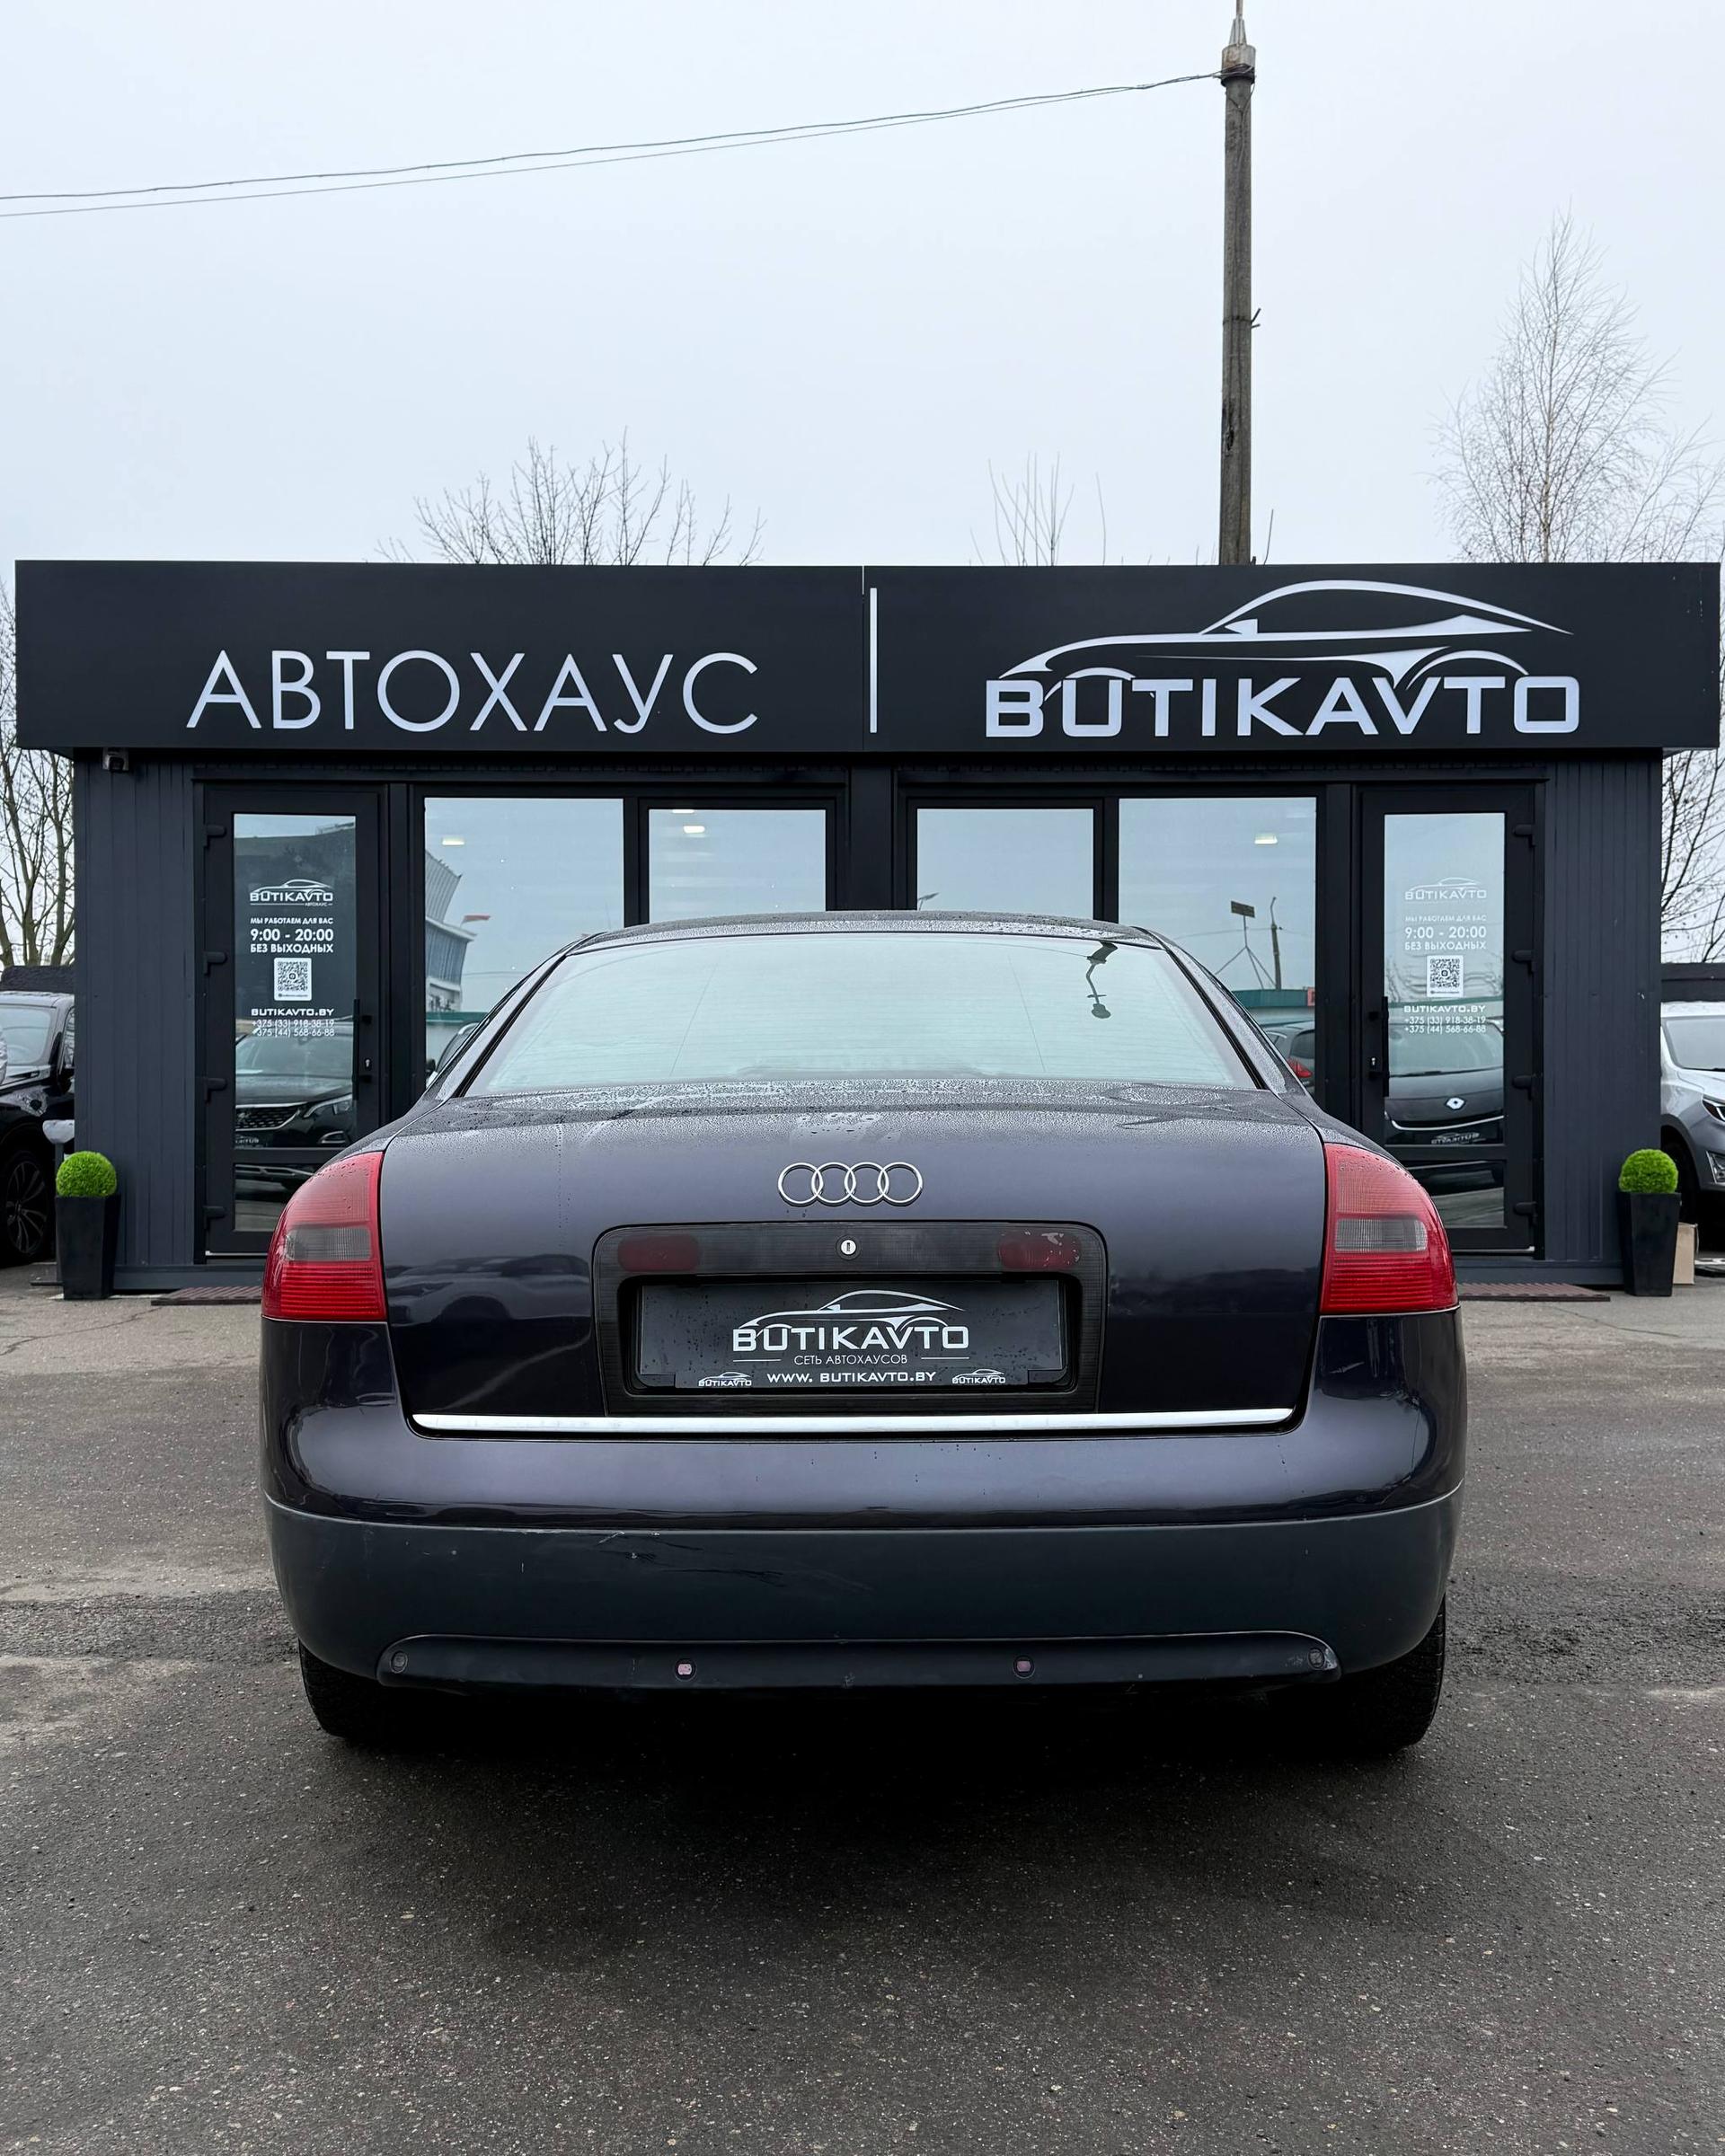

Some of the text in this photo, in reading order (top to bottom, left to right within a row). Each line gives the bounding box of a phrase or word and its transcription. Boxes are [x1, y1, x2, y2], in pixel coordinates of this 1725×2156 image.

[186, 649, 758, 734] АВТОХАУС
[986, 675, 1579, 737] BUTIKAVTO
[250, 892, 333, 902] BUTIKAVTO
[1404, 889, 1487, 900] BUTIKAVTO
[251, 928, 280, 941] 9:00
[295, 928, 333, 941] 20:00
[1405, 926, 1434, 939] 9:00
[1448, 926, 1487, 939] 20:00
[251, 944, 333, 954] БЕЗ ВЫХОДНЫХ
[1404, 941, 1486, 950] БЕЗ ВЫХОДНЫХ
[251, 1008, 334, 1016] BUTIKAVTO.BY
[1403, 1005, 1486, 1013] BUTIKAVTO.BY
[252, 1019, 335, 1029] +375 (33) 918-38-19
[1404, 1016, 1486, 1025] +375 (33) 918-38-19
[275, 1028, 291, 1038] (44)
[293, 1028, 335, 1037] 568-66-88
[1404, 1025, 1487, 1035] +375 (44) 568-66-88
[733, 1326, 969, 1351] BUTIKAVTO
[794, 1355, 907, 1365] СЕТЬ АВТОХАУСОВ
[820, 1371, 936, 1383] BUTIKAVTO.BY
[952, 1376, 1006, 1384] BUTIKAVTO
[698, 1379, 752, 1387] BUTIKAVTO
